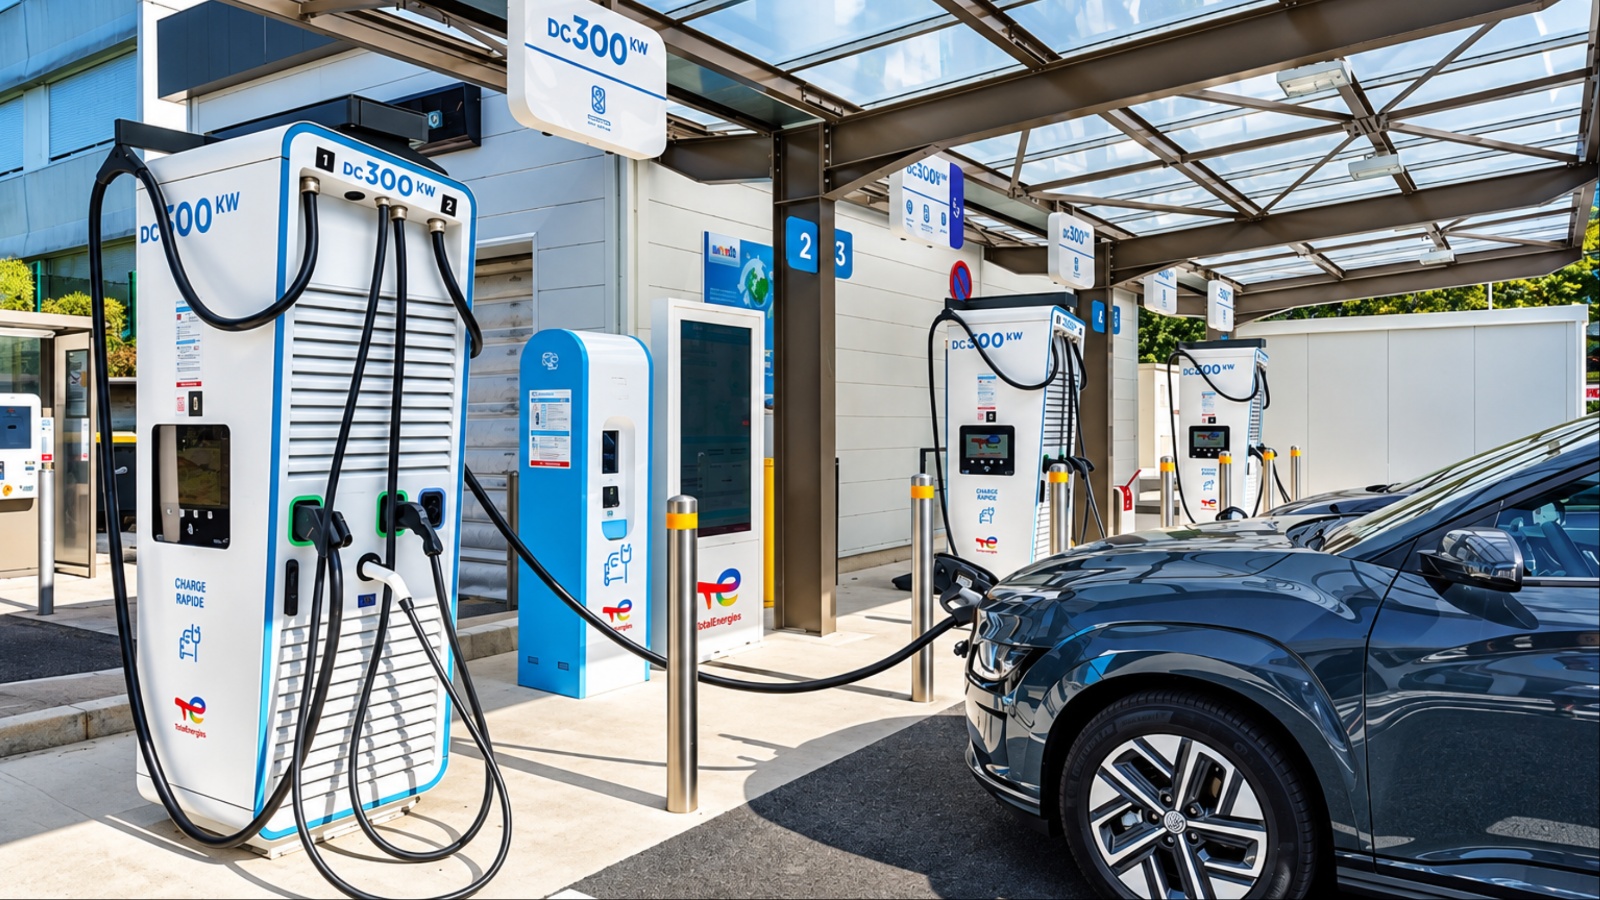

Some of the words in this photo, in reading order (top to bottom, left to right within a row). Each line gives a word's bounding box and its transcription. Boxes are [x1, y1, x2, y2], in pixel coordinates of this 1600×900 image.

[323, 154, 328, 166] 1
[416, 181, 436, 197] KW
[216, 191, 240, 214] KW
[446, 200, 452, 212] 2
[800, 232, 811, 260] 2
[835, 241, 846, 266] 3
[174, 577, 206, 593] CHARGE
[176, 593, 204, 608] RAPIDE
